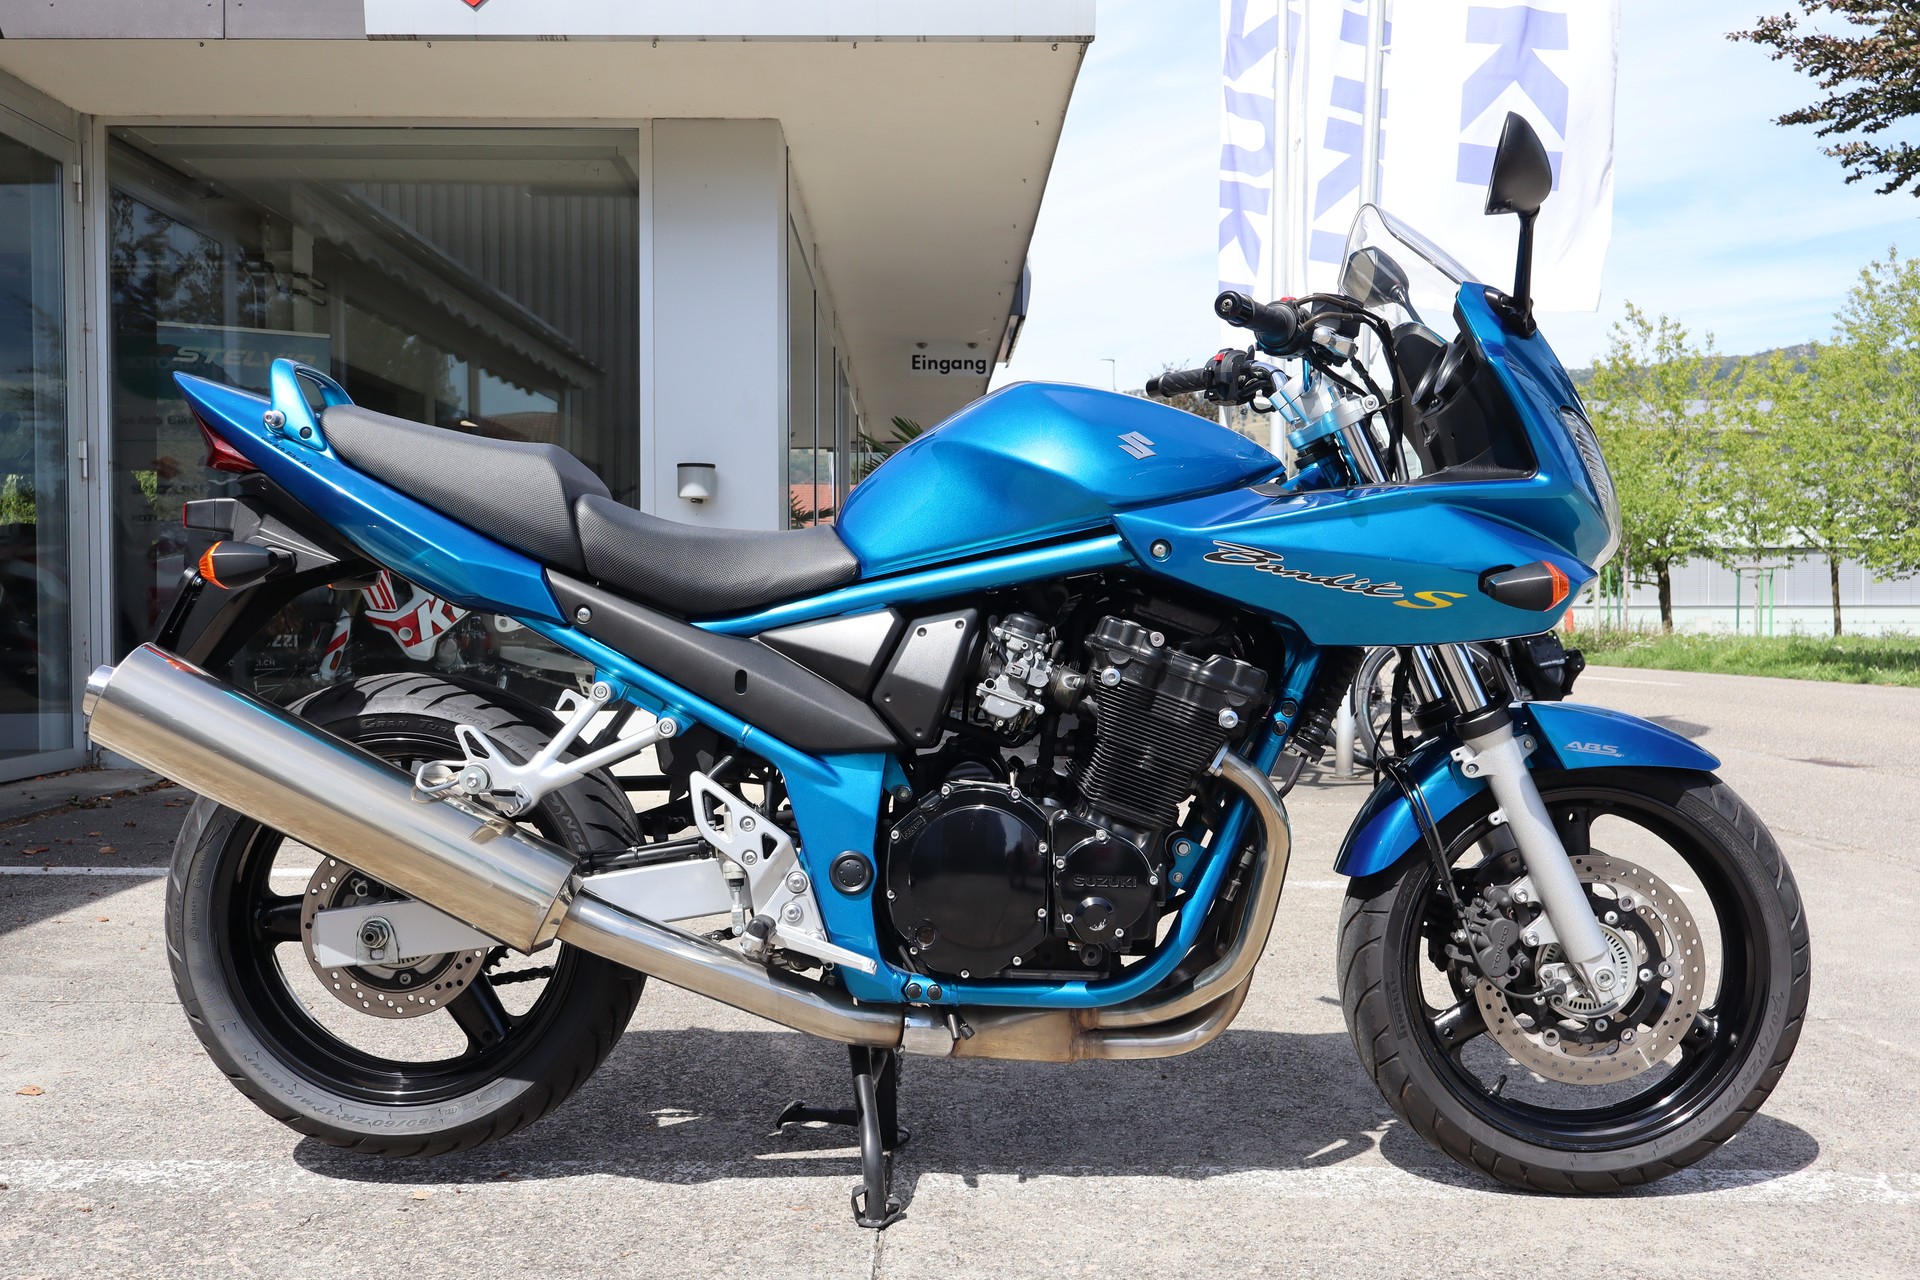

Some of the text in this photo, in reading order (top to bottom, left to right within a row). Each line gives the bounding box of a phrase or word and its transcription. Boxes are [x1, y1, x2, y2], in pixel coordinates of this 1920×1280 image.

[911, 354, 988, 375] Eingang
[1203, 539, 1468, 610] Bandit S
[1563, 740, 1620, 755] ABS
[1072, 874, 1138, 889] SUZUKI
